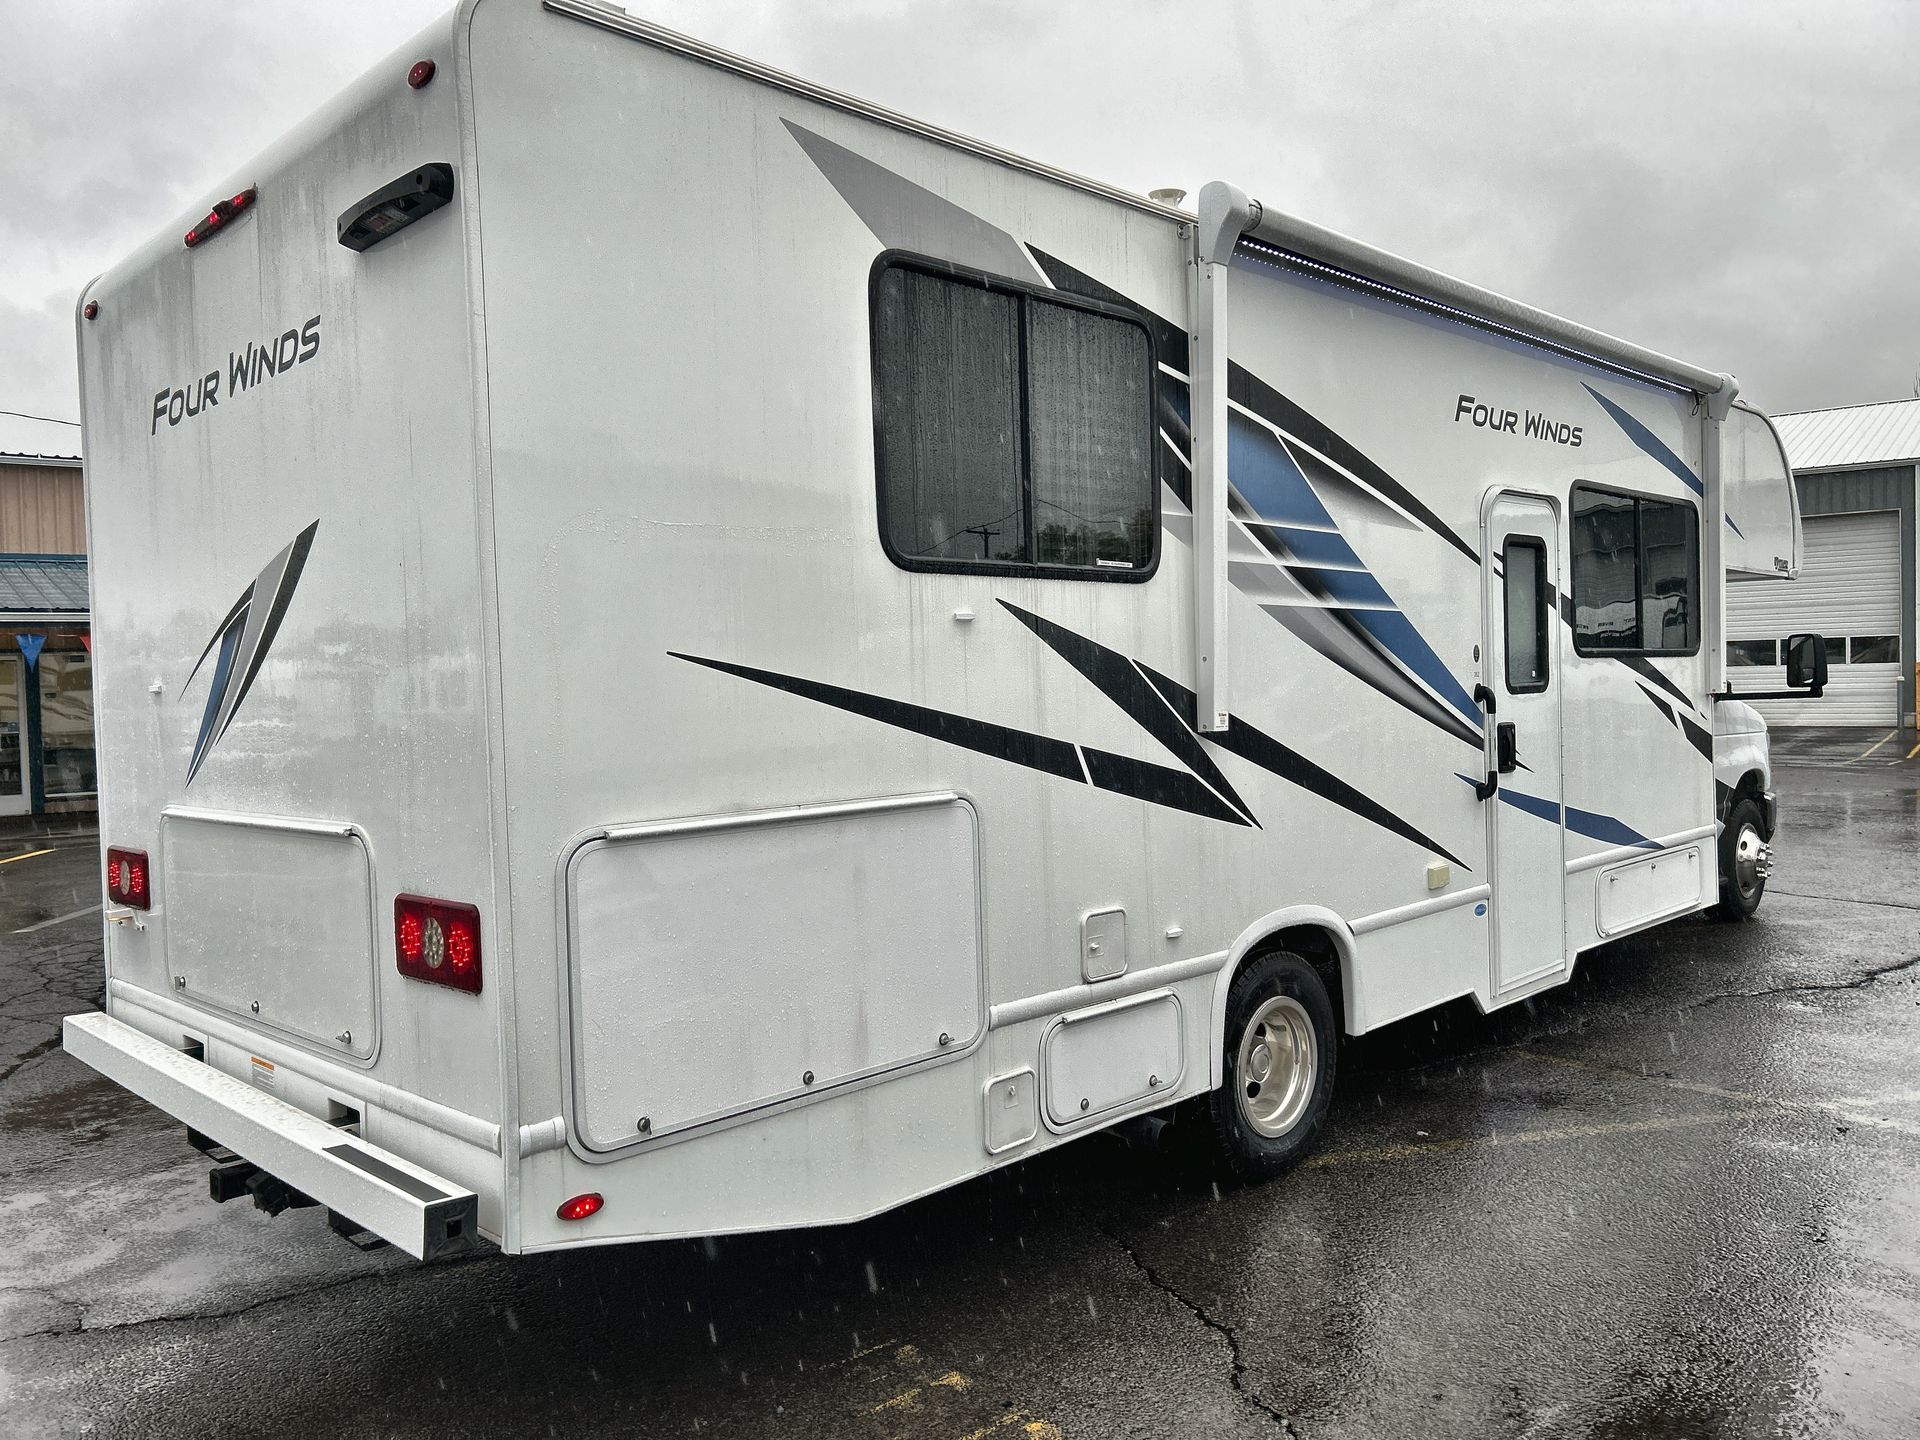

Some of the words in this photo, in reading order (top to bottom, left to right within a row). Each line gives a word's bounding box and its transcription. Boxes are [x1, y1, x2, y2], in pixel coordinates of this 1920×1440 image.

[151, 369, 220, 436] FOUR
[229, 314, 321, 398] WINDS
[1454, 394, 1519, 434] FOUR
[1524, 409, 1583, 447] WINDS
